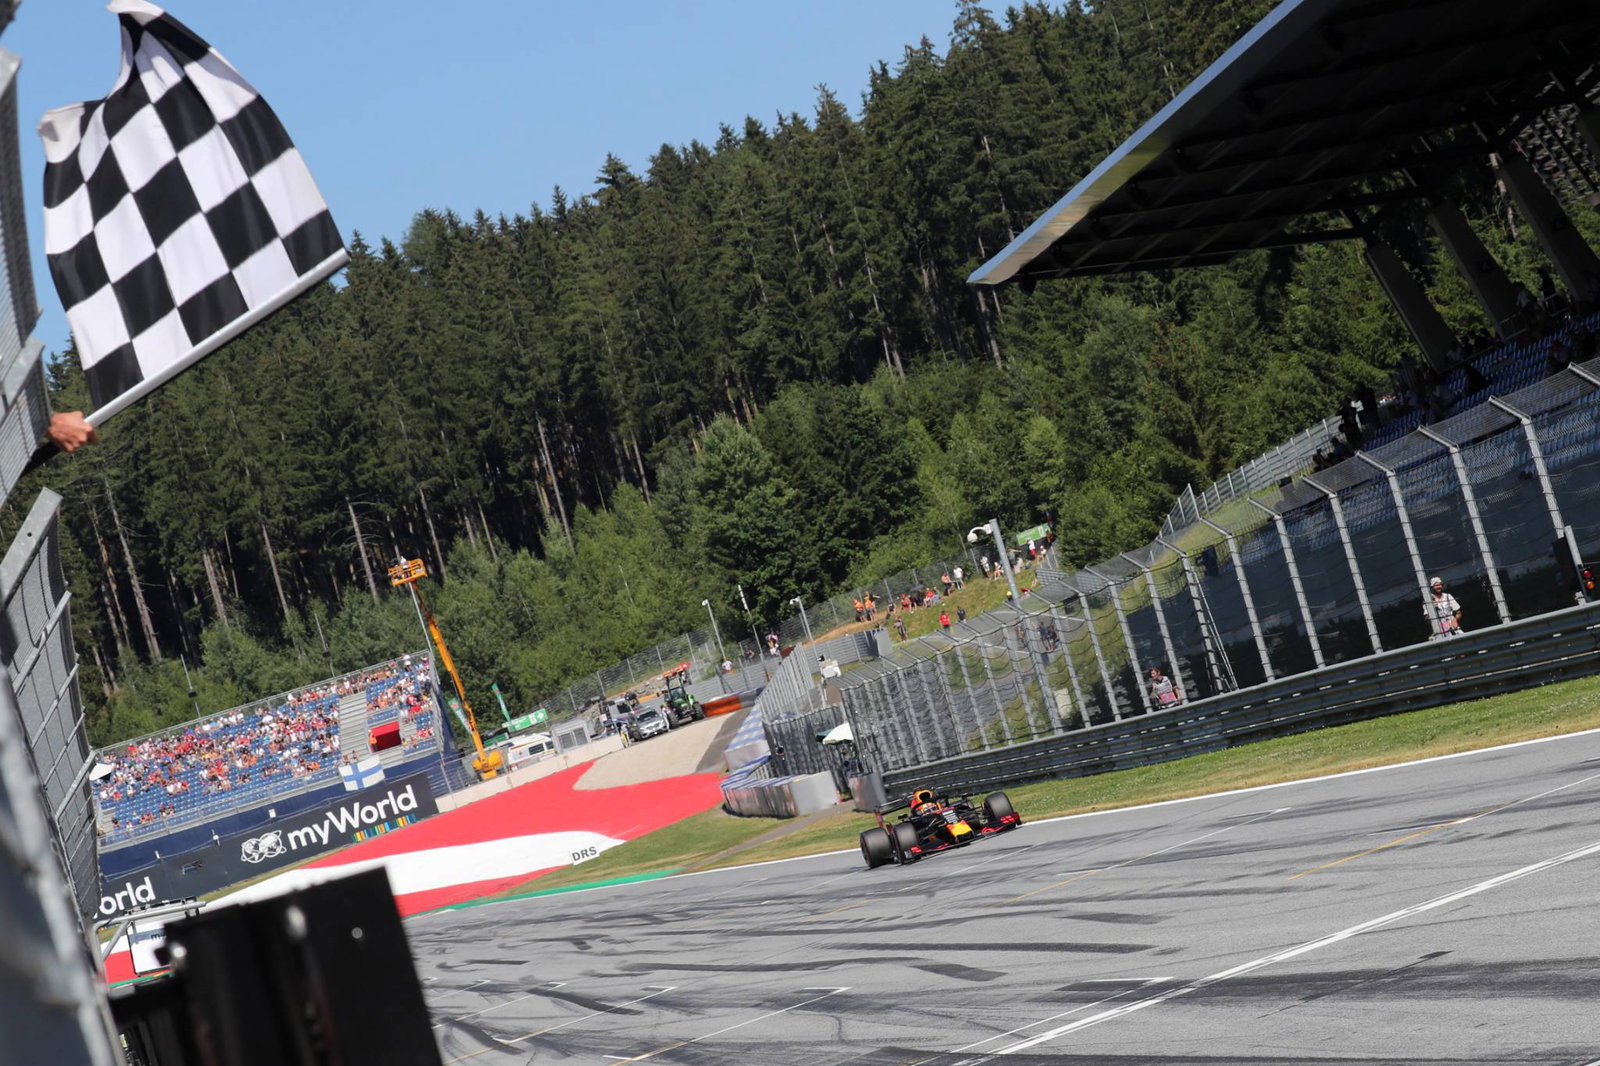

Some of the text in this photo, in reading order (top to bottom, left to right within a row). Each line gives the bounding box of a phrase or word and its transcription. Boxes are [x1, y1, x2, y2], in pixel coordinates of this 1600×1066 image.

[287, 784, 418, 850] myWorld
[571, 846, 597, 862] DRS
[94, 876, 156, 919] orld
